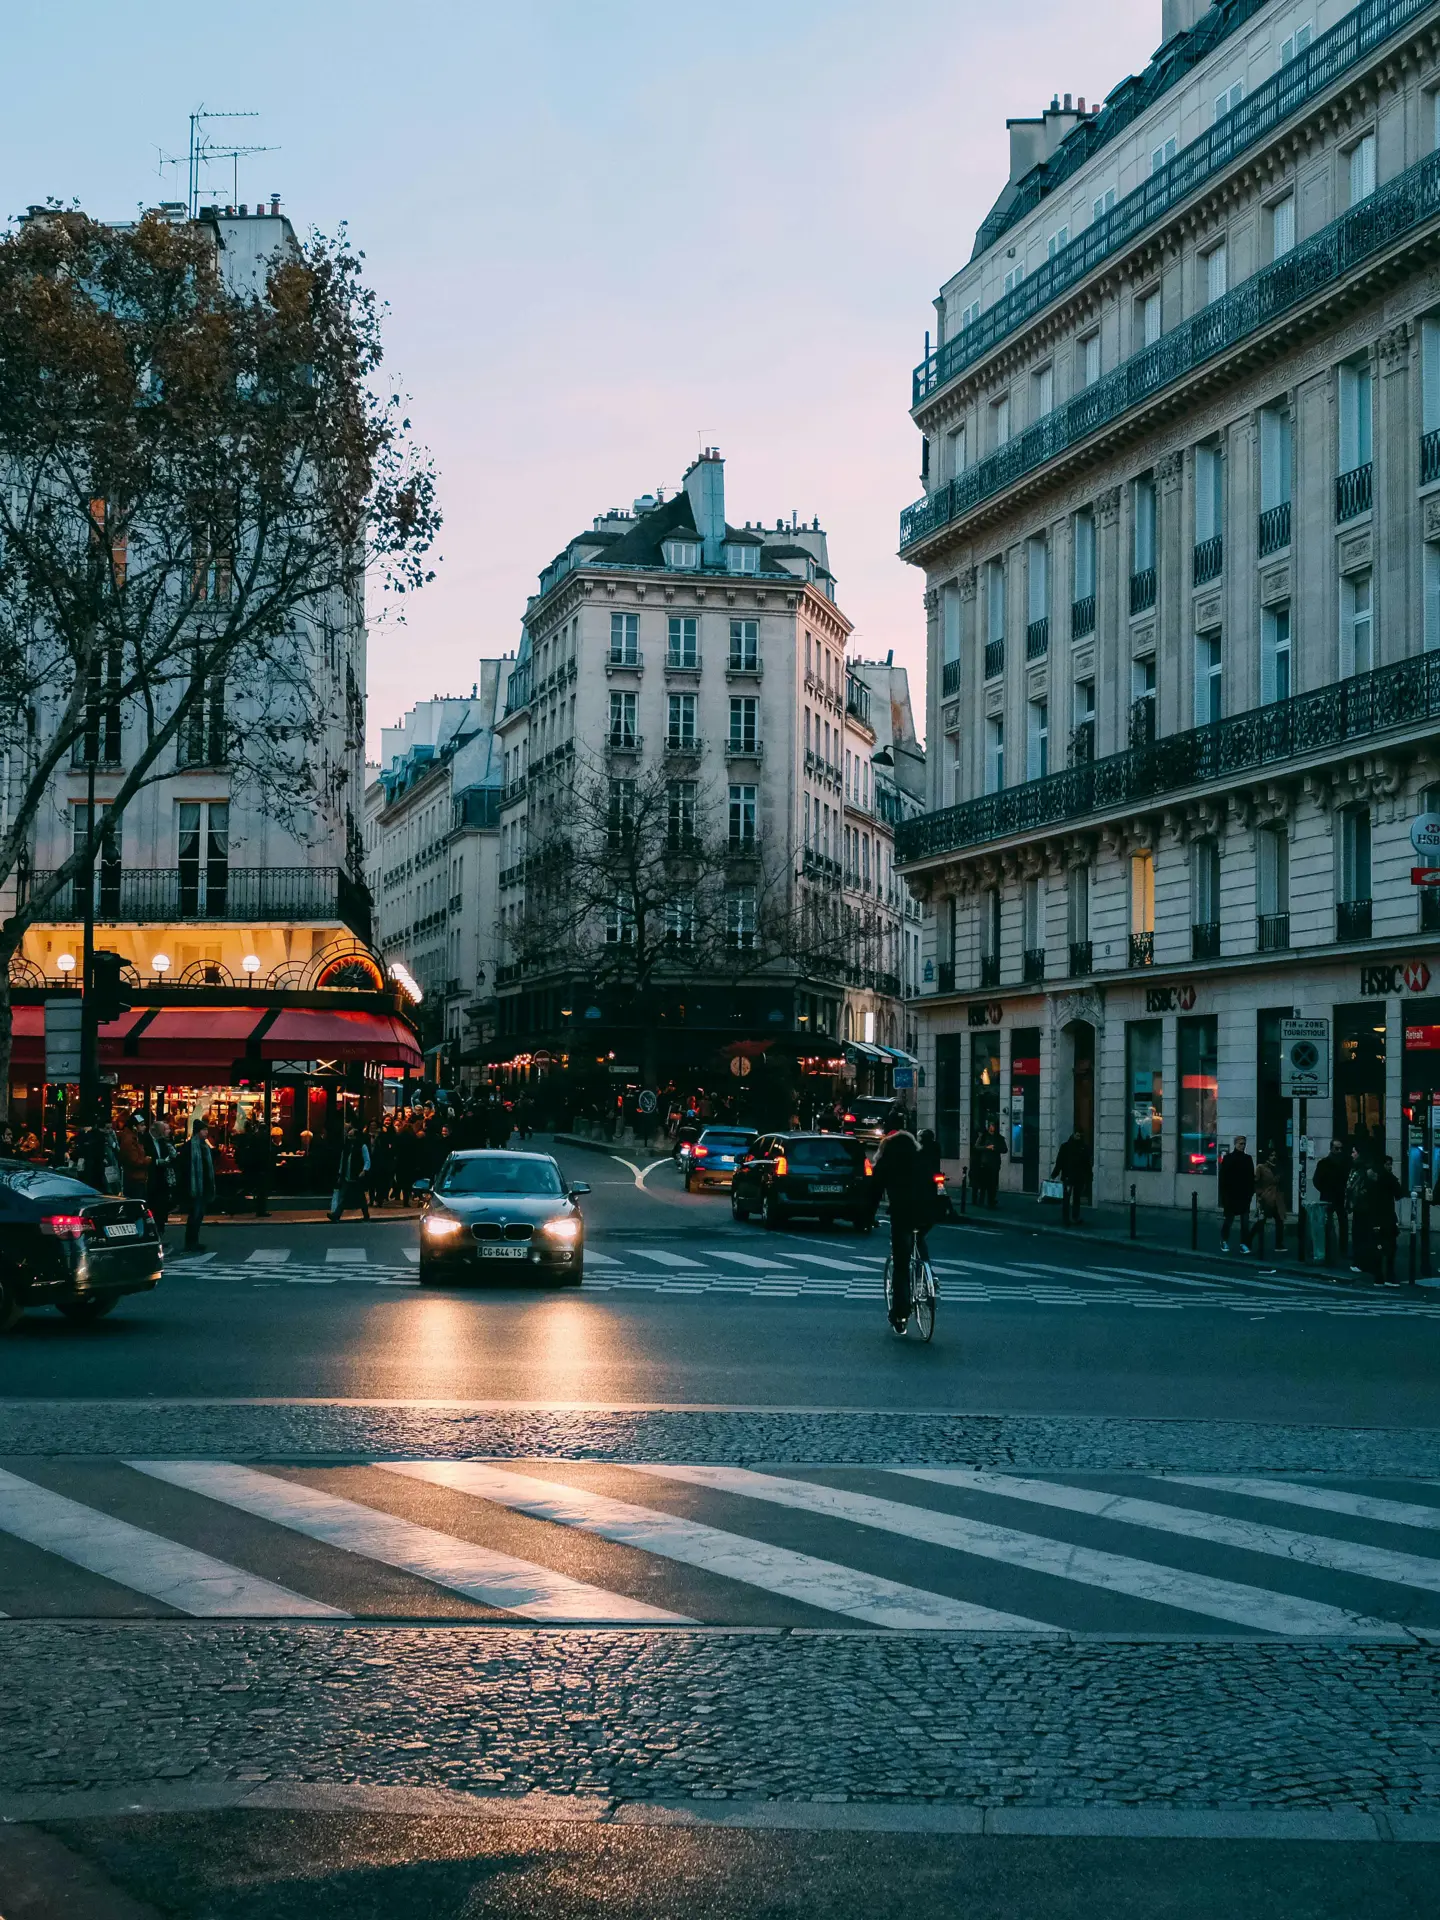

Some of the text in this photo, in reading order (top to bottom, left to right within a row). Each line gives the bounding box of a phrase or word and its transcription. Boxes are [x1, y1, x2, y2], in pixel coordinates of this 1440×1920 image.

[1416, 834, 1440, 845] HSB
[1360, 965, 1403, 995] HSBC
[1146, 987, 1178, 1012] HSBC
[1284, 1029, 1326, 1037] TOURISTIQUE
[483, 1247, 522, 1257] CG-644-TS
